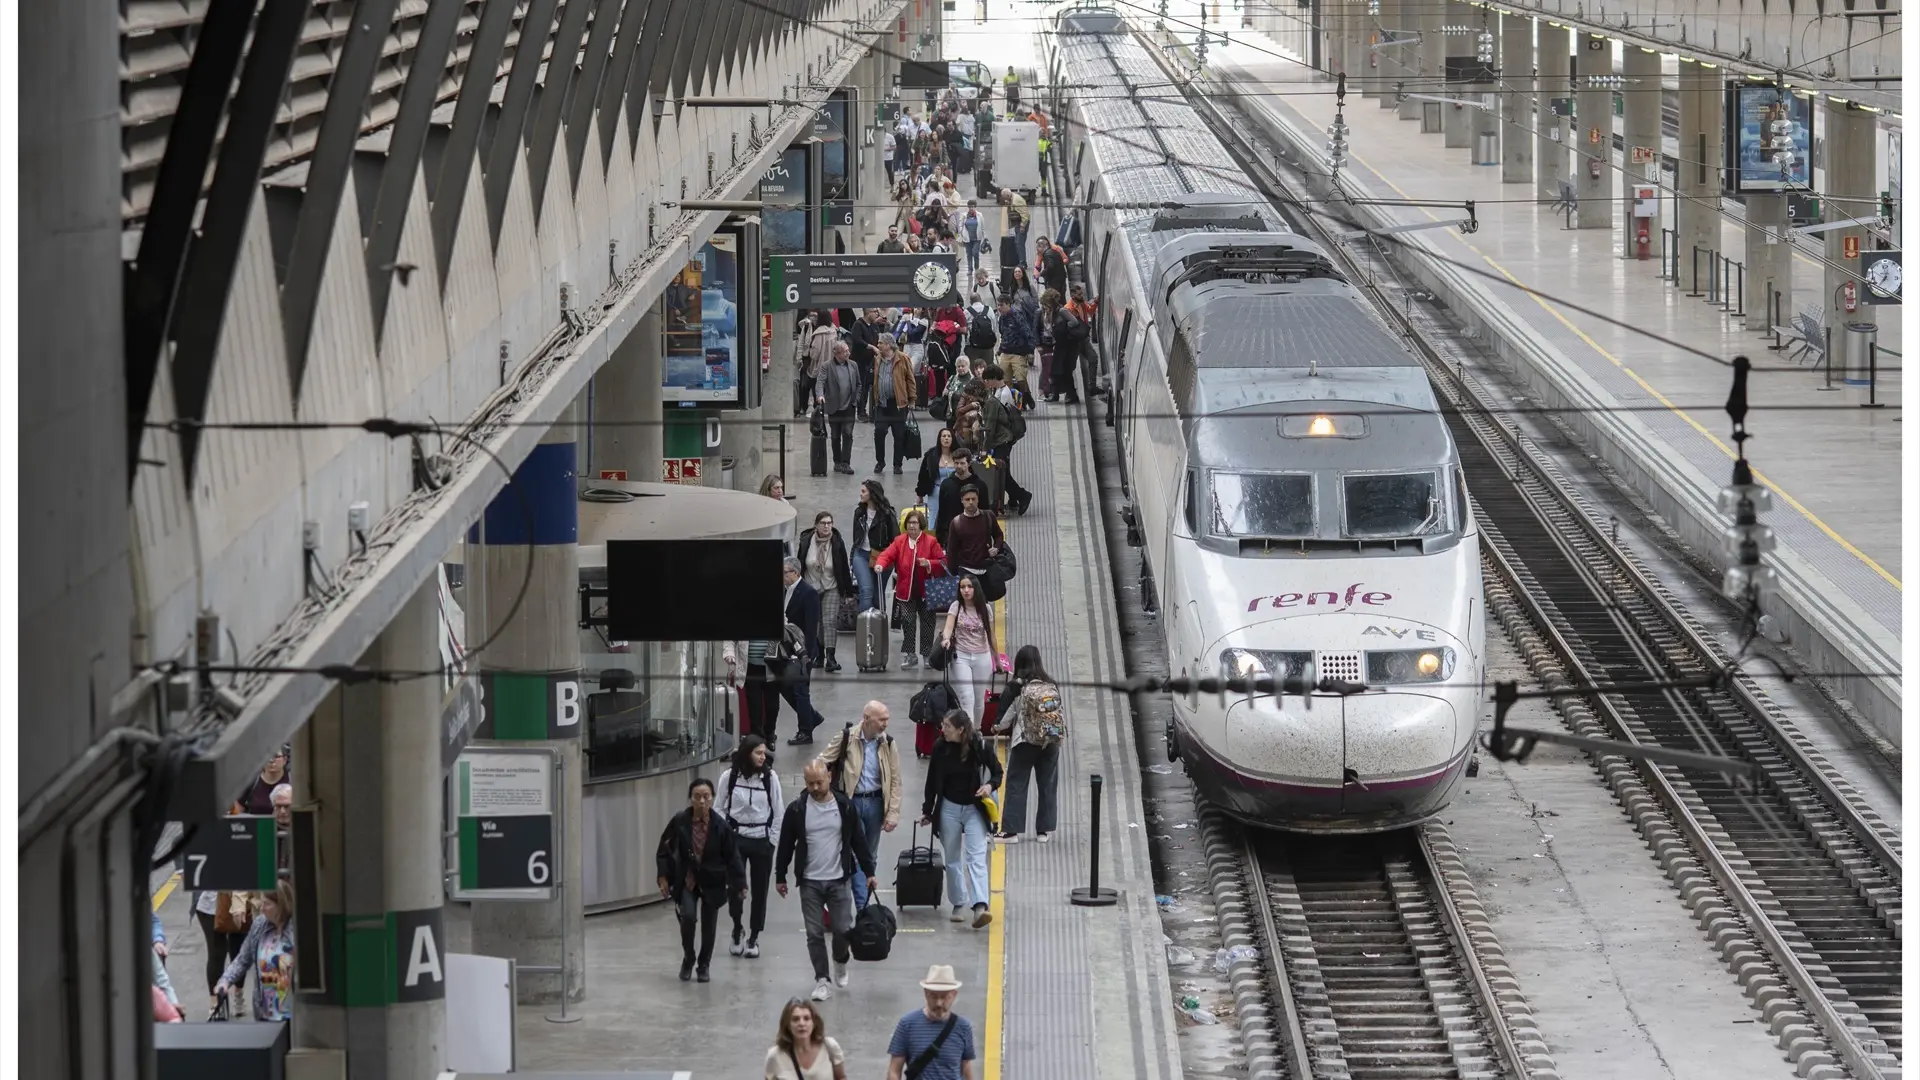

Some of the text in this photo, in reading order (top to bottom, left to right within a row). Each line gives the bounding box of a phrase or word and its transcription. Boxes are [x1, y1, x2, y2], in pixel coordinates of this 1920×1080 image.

[894, 110, 900, 120] 6
[1551, 106, 1557, 115] 5
[866, 128, 875, 144] K
[844, 212, 853, 225] 6
[1788, 205, 1796, 217] 5
[785, 283, 800, 304] 6
[706, 417, 722, 447] D
[1247, 583, 1392, 612] renfe
[1361, 625, 1436, 641] AVE
[556, 681, 580, 727] B
[188, 855, 207, 886] 7
[527, 850, 549, 884] 6
[405, 925, 443, 987] A
